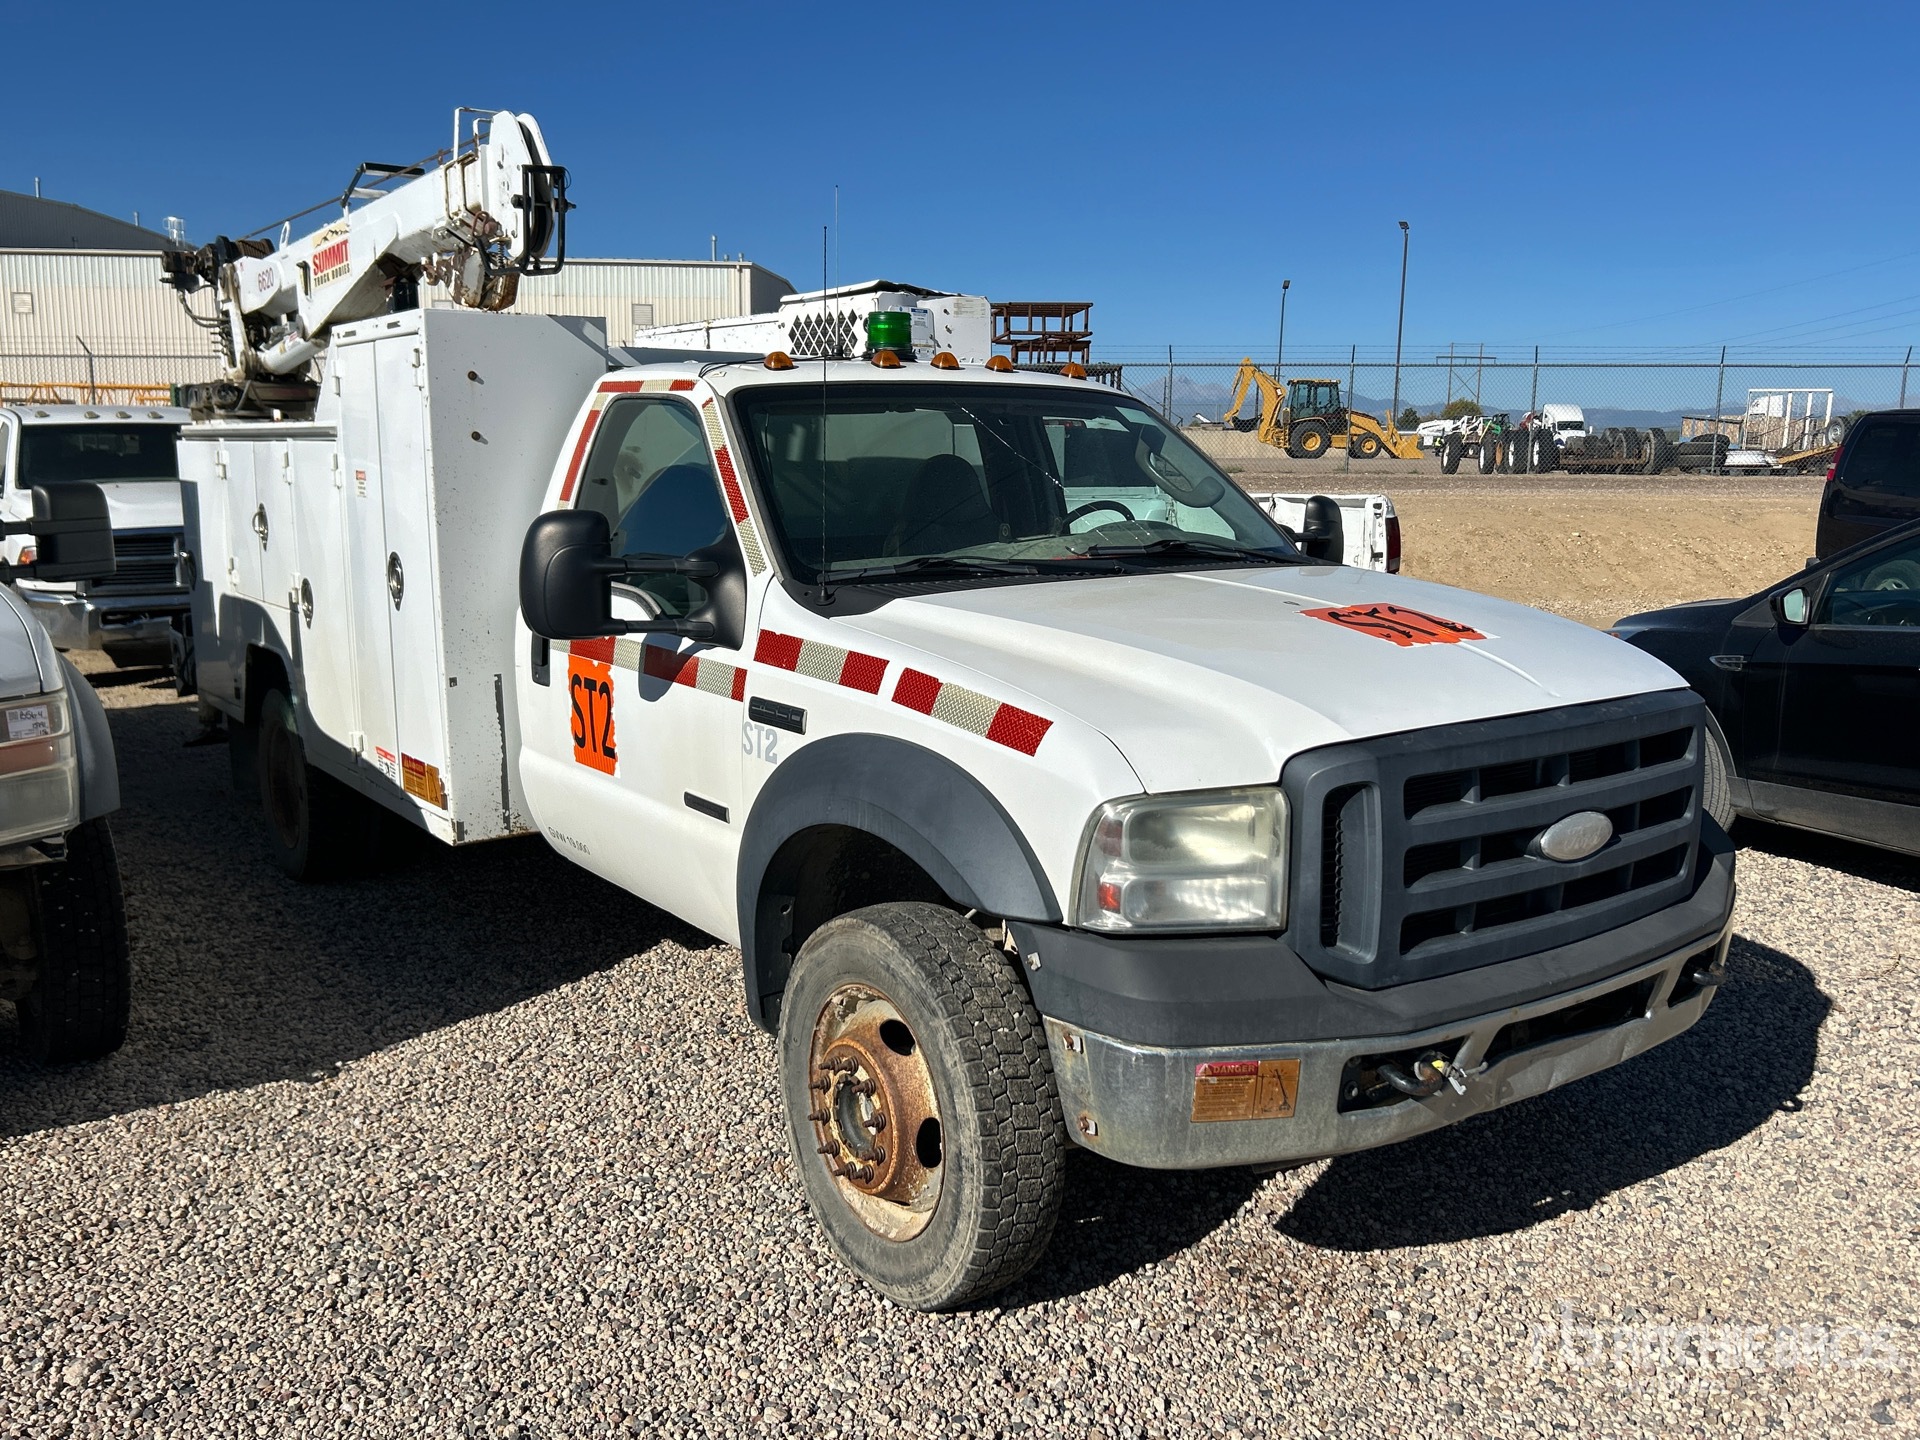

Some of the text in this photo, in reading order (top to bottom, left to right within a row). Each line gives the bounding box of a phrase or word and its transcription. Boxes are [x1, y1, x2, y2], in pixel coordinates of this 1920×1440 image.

[313, 239, 349, 276] SUMMIT
[258, 267, 274, 292] 6620
[314, 263, 350, 287] TRUCK BODIES
[571, 673, 616, 760] ST2
[742, 721, 778, 765] ST2
[1213, 1064, 1255, 1074] DANGER
